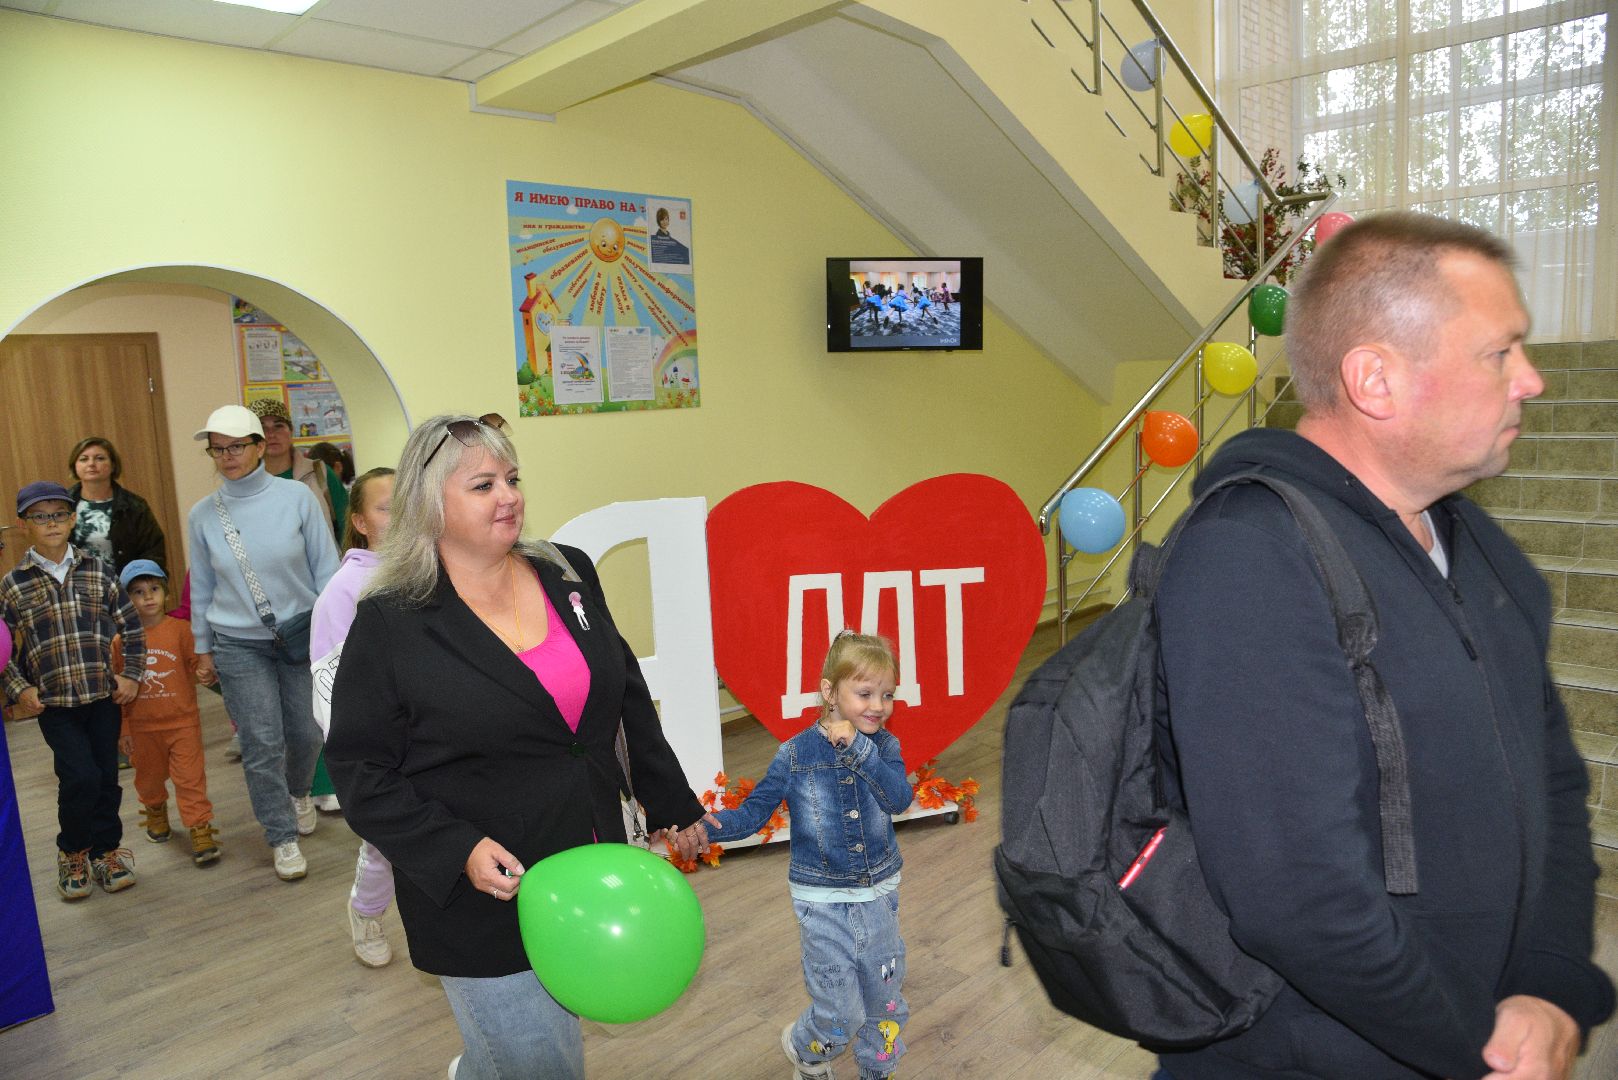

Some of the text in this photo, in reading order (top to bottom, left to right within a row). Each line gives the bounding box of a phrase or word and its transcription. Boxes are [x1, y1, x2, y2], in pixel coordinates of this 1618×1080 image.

[514, 192, 637, 212] Я ИМЕЮ ПРАВО НА
[550, 249, 588, 280] образование
[624, 255, 656, 282] получение
[589, 281, 600, 313] любовь
[617, 276, 627, 301] отдых
[614, 293, 625, 316] досуг
[782, 567, 985, 719] ДДТ
